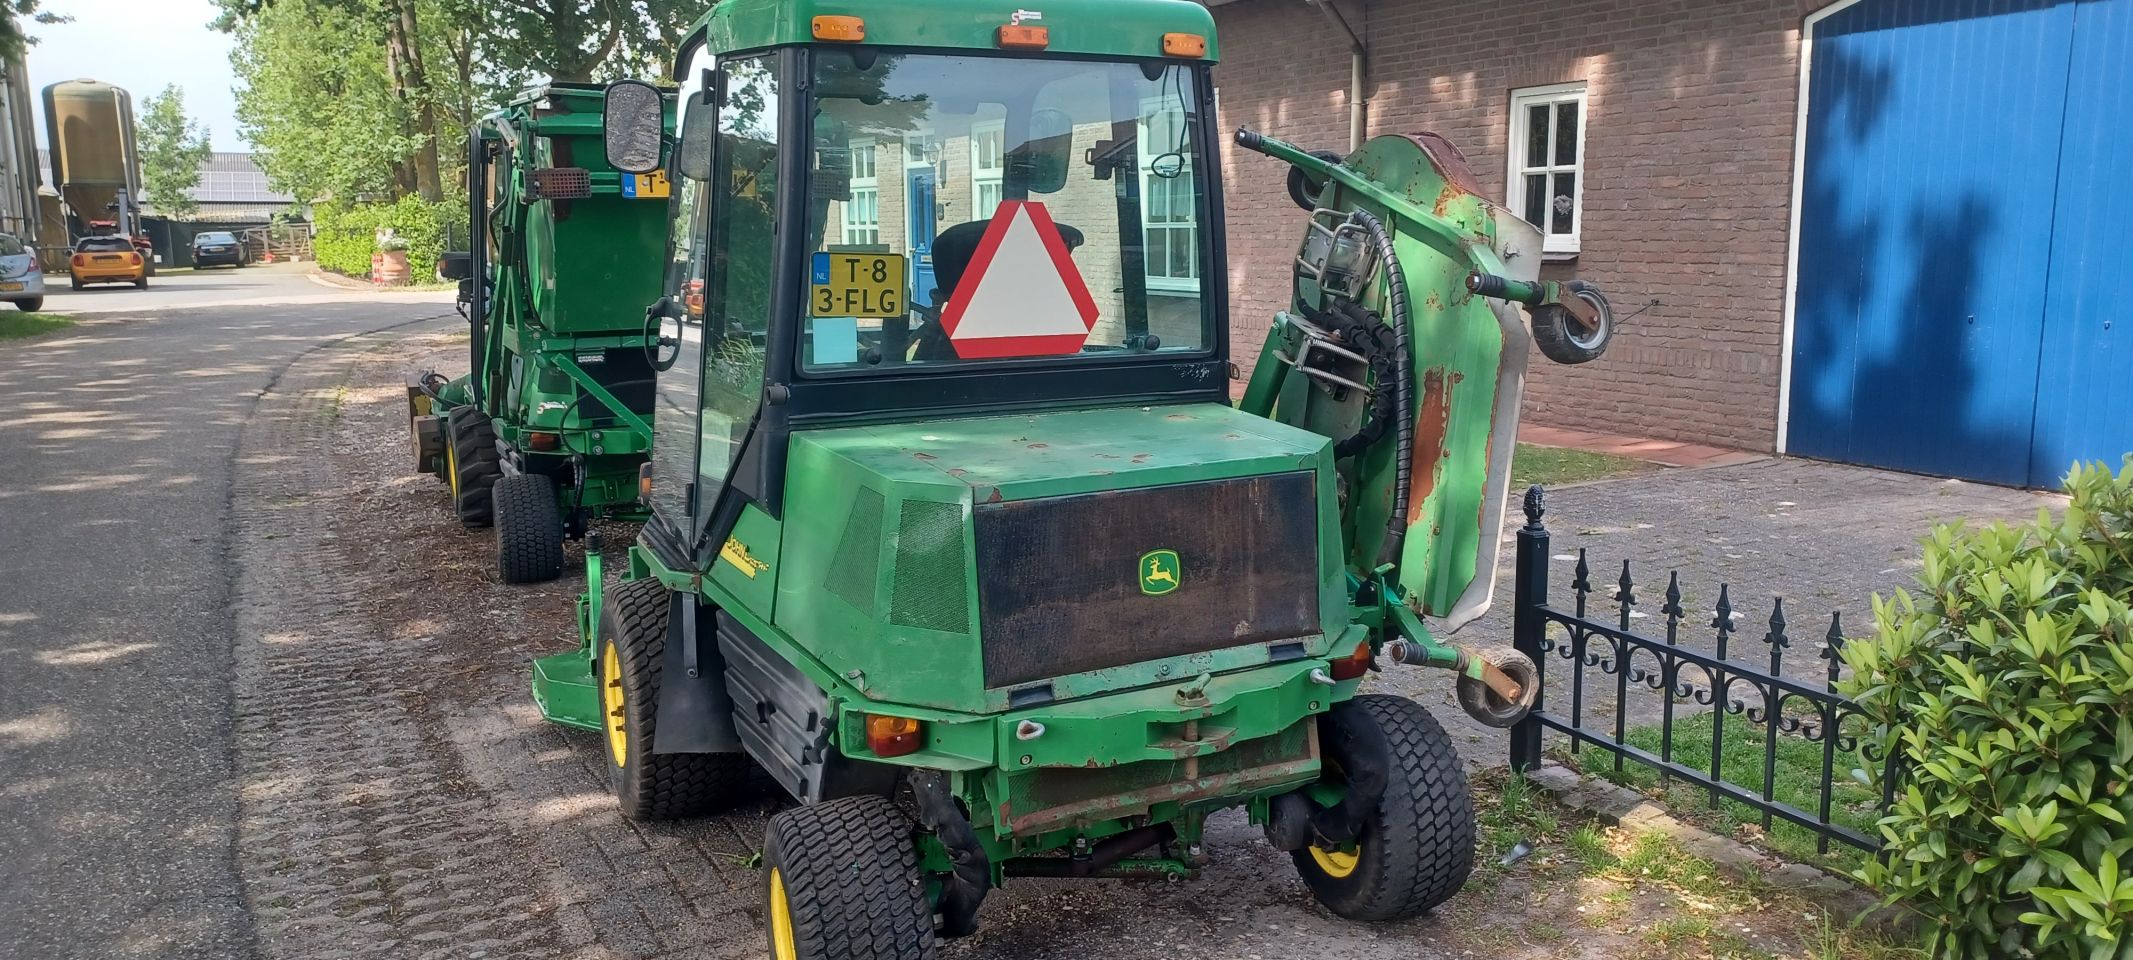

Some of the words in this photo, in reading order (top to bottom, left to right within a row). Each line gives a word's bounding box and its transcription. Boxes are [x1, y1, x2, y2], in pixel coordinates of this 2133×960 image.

[816, 272, 827, 280] NL
[845, 259, 887, 283] T-8
[818, 288, 895, 313] 3-FLG
